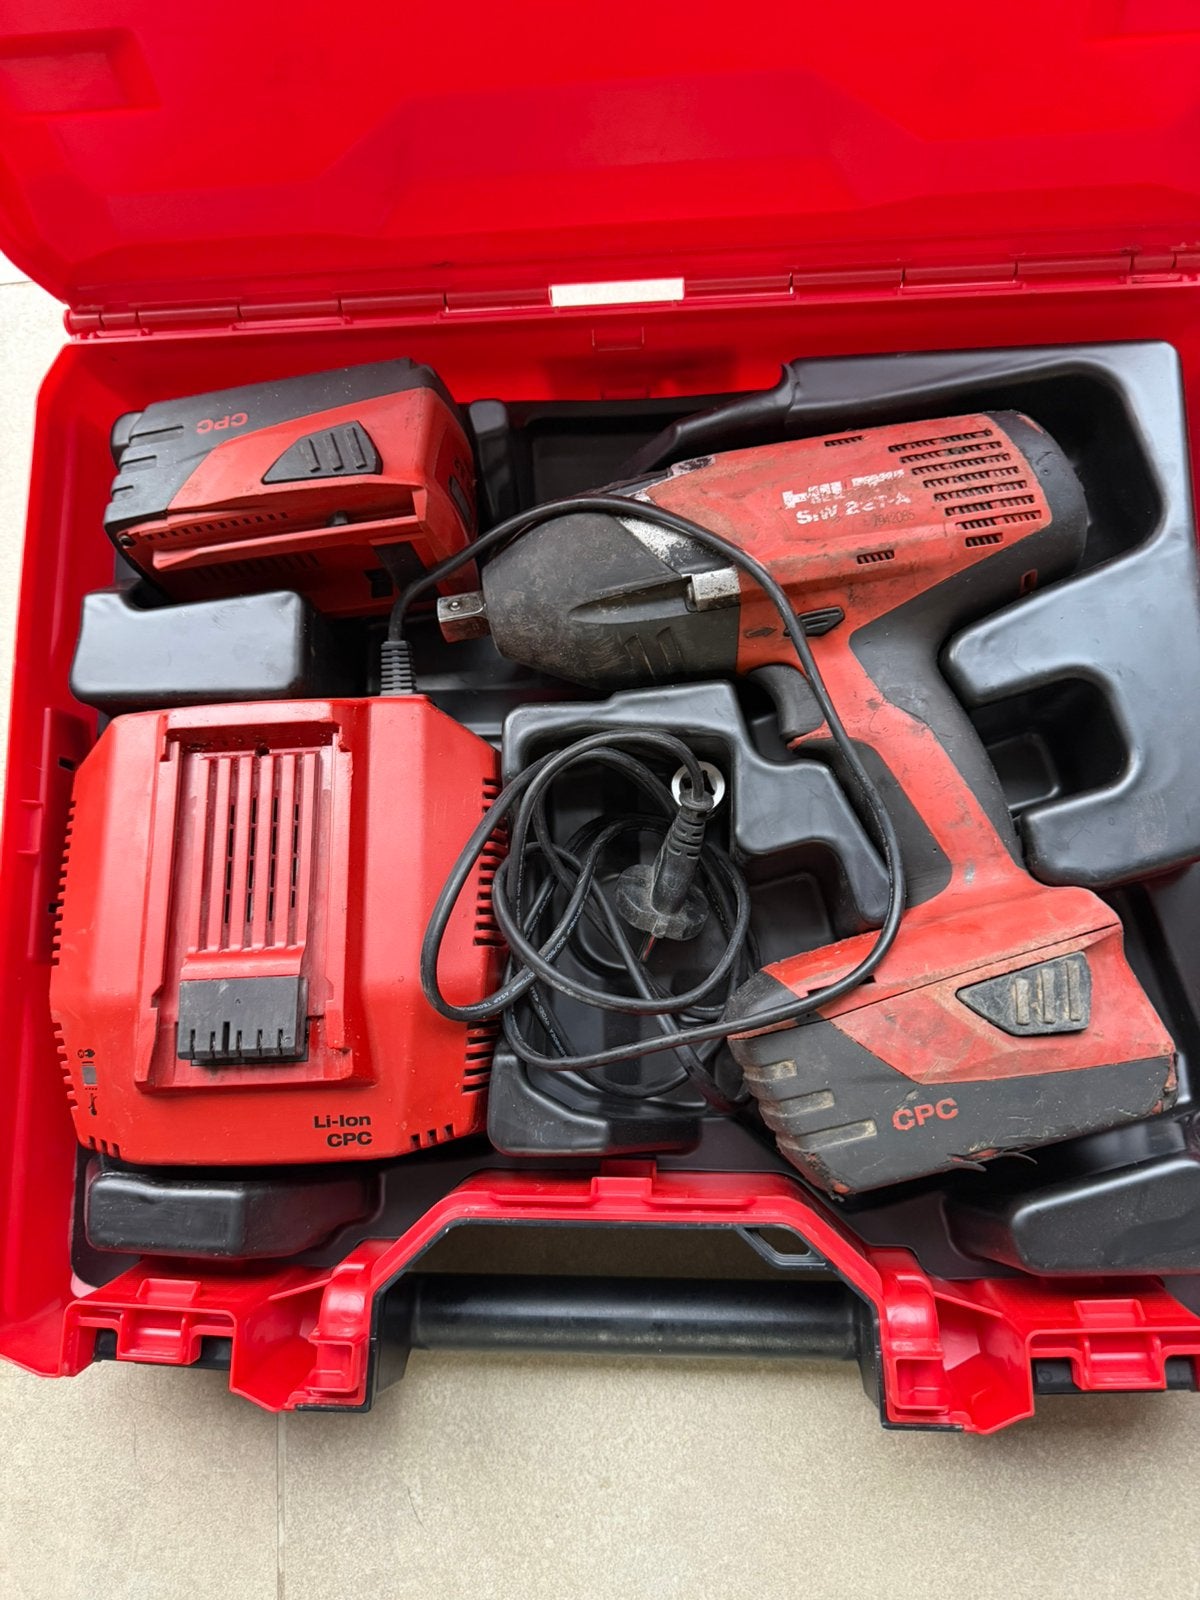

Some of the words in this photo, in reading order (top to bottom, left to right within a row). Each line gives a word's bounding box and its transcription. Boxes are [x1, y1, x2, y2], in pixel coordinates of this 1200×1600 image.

[196, 412, 248, 433] CPC
[314, 1115, 371, 1128] Li-Ion
[892, 1098, 958, 1130] CPC
[327, 1131, 372, 1147] CPC
